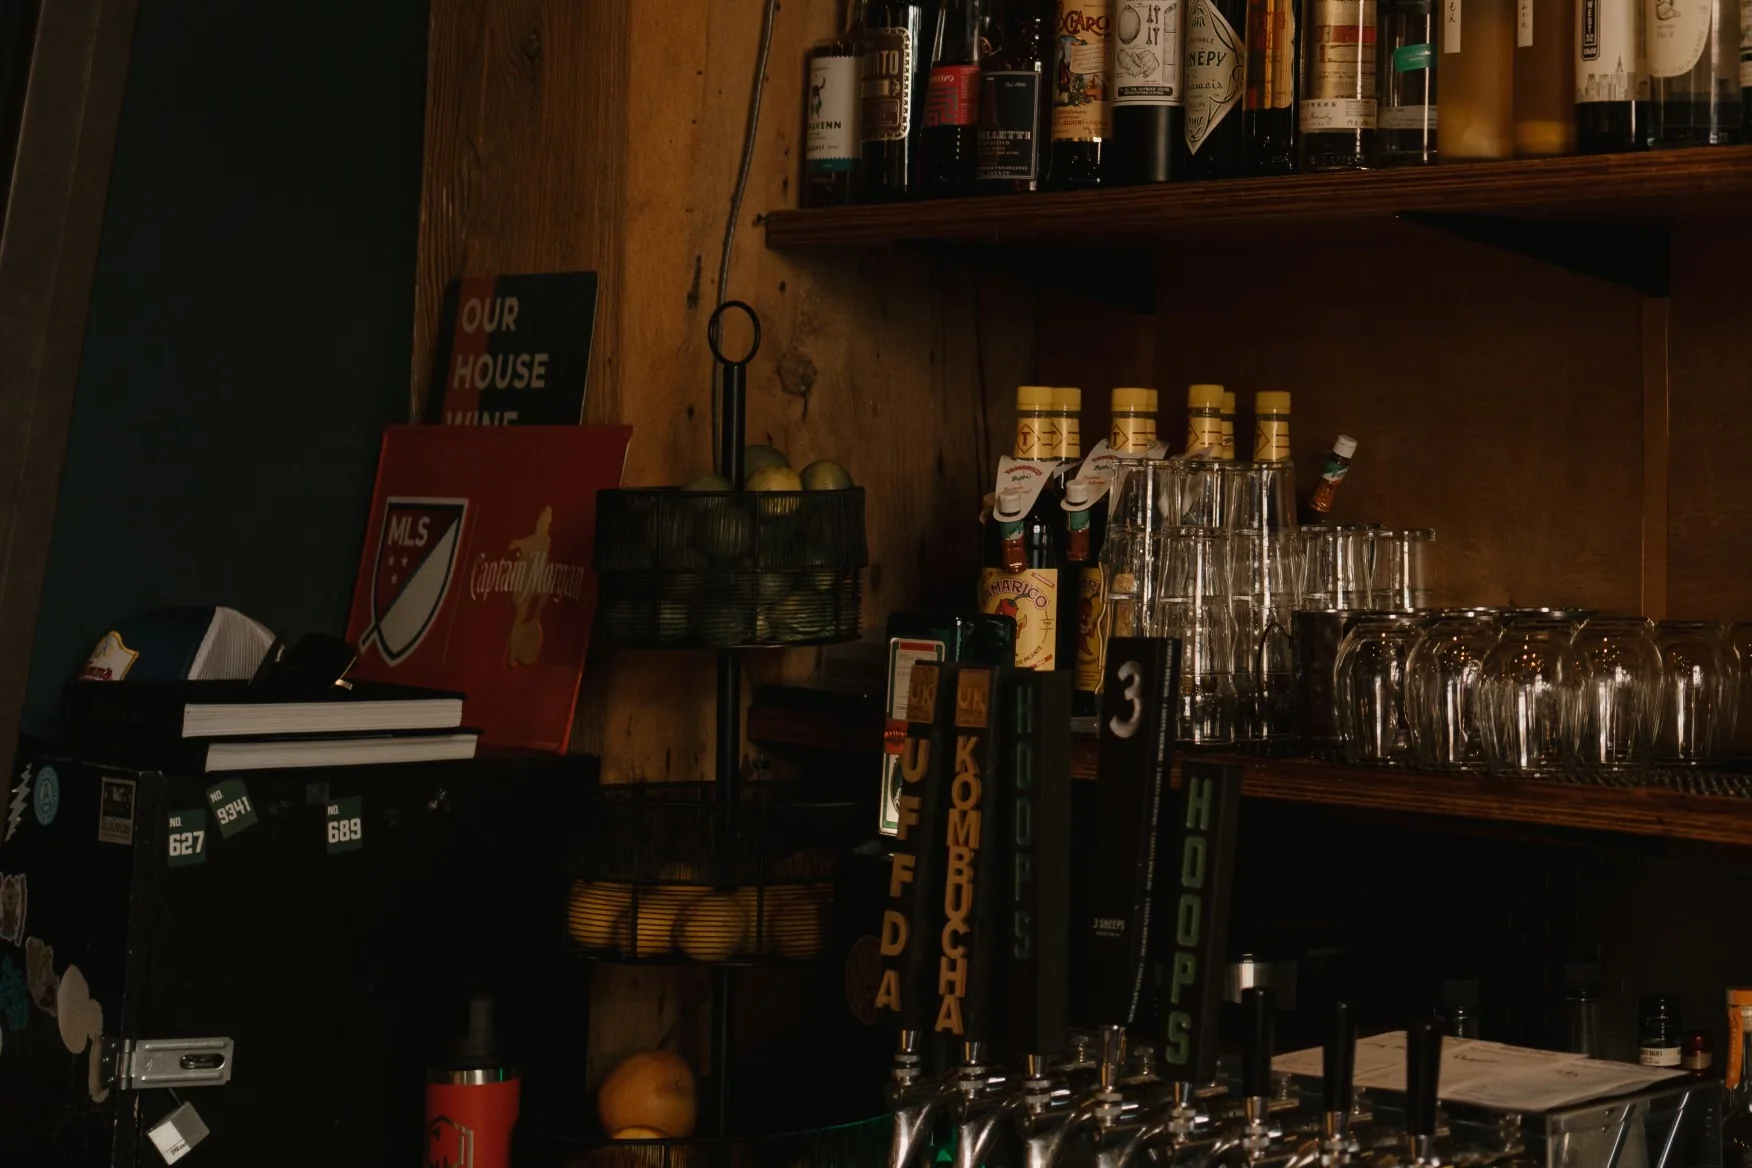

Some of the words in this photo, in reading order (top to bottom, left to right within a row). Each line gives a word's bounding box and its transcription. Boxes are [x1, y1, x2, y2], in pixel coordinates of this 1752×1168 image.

[1586, 0, 1595, 31] WEST
[1584, 33, 1595, 43] 32
[461, 296, 520, 334] OUR
[453, 352, 549, 390] HOUSE
[388, 515, 432, 547] MLS
[470, 552, 528, 602] Captain
[525, 550, 585, 604] Morgan
[1108, 659, 1145, 740] 3
[210, 789, 225, 804] NO.
[215, 796, 253, 825] 9341
[327, 804, 341, 817] NO.
[168, 817, 183, 829] NO.
[327, 818, 363, 845] 689
[1013, 684, 1034, 961] HOOPS
[167, 830, 206, 857] 627
[933, 735, 984, 1037] KOMBUCHA
[1092, 917, 1099, 931] 3
[1100, 917, 1126, 932] SHEEPS
[1164, 776, 1214, 1067] HOOPS
